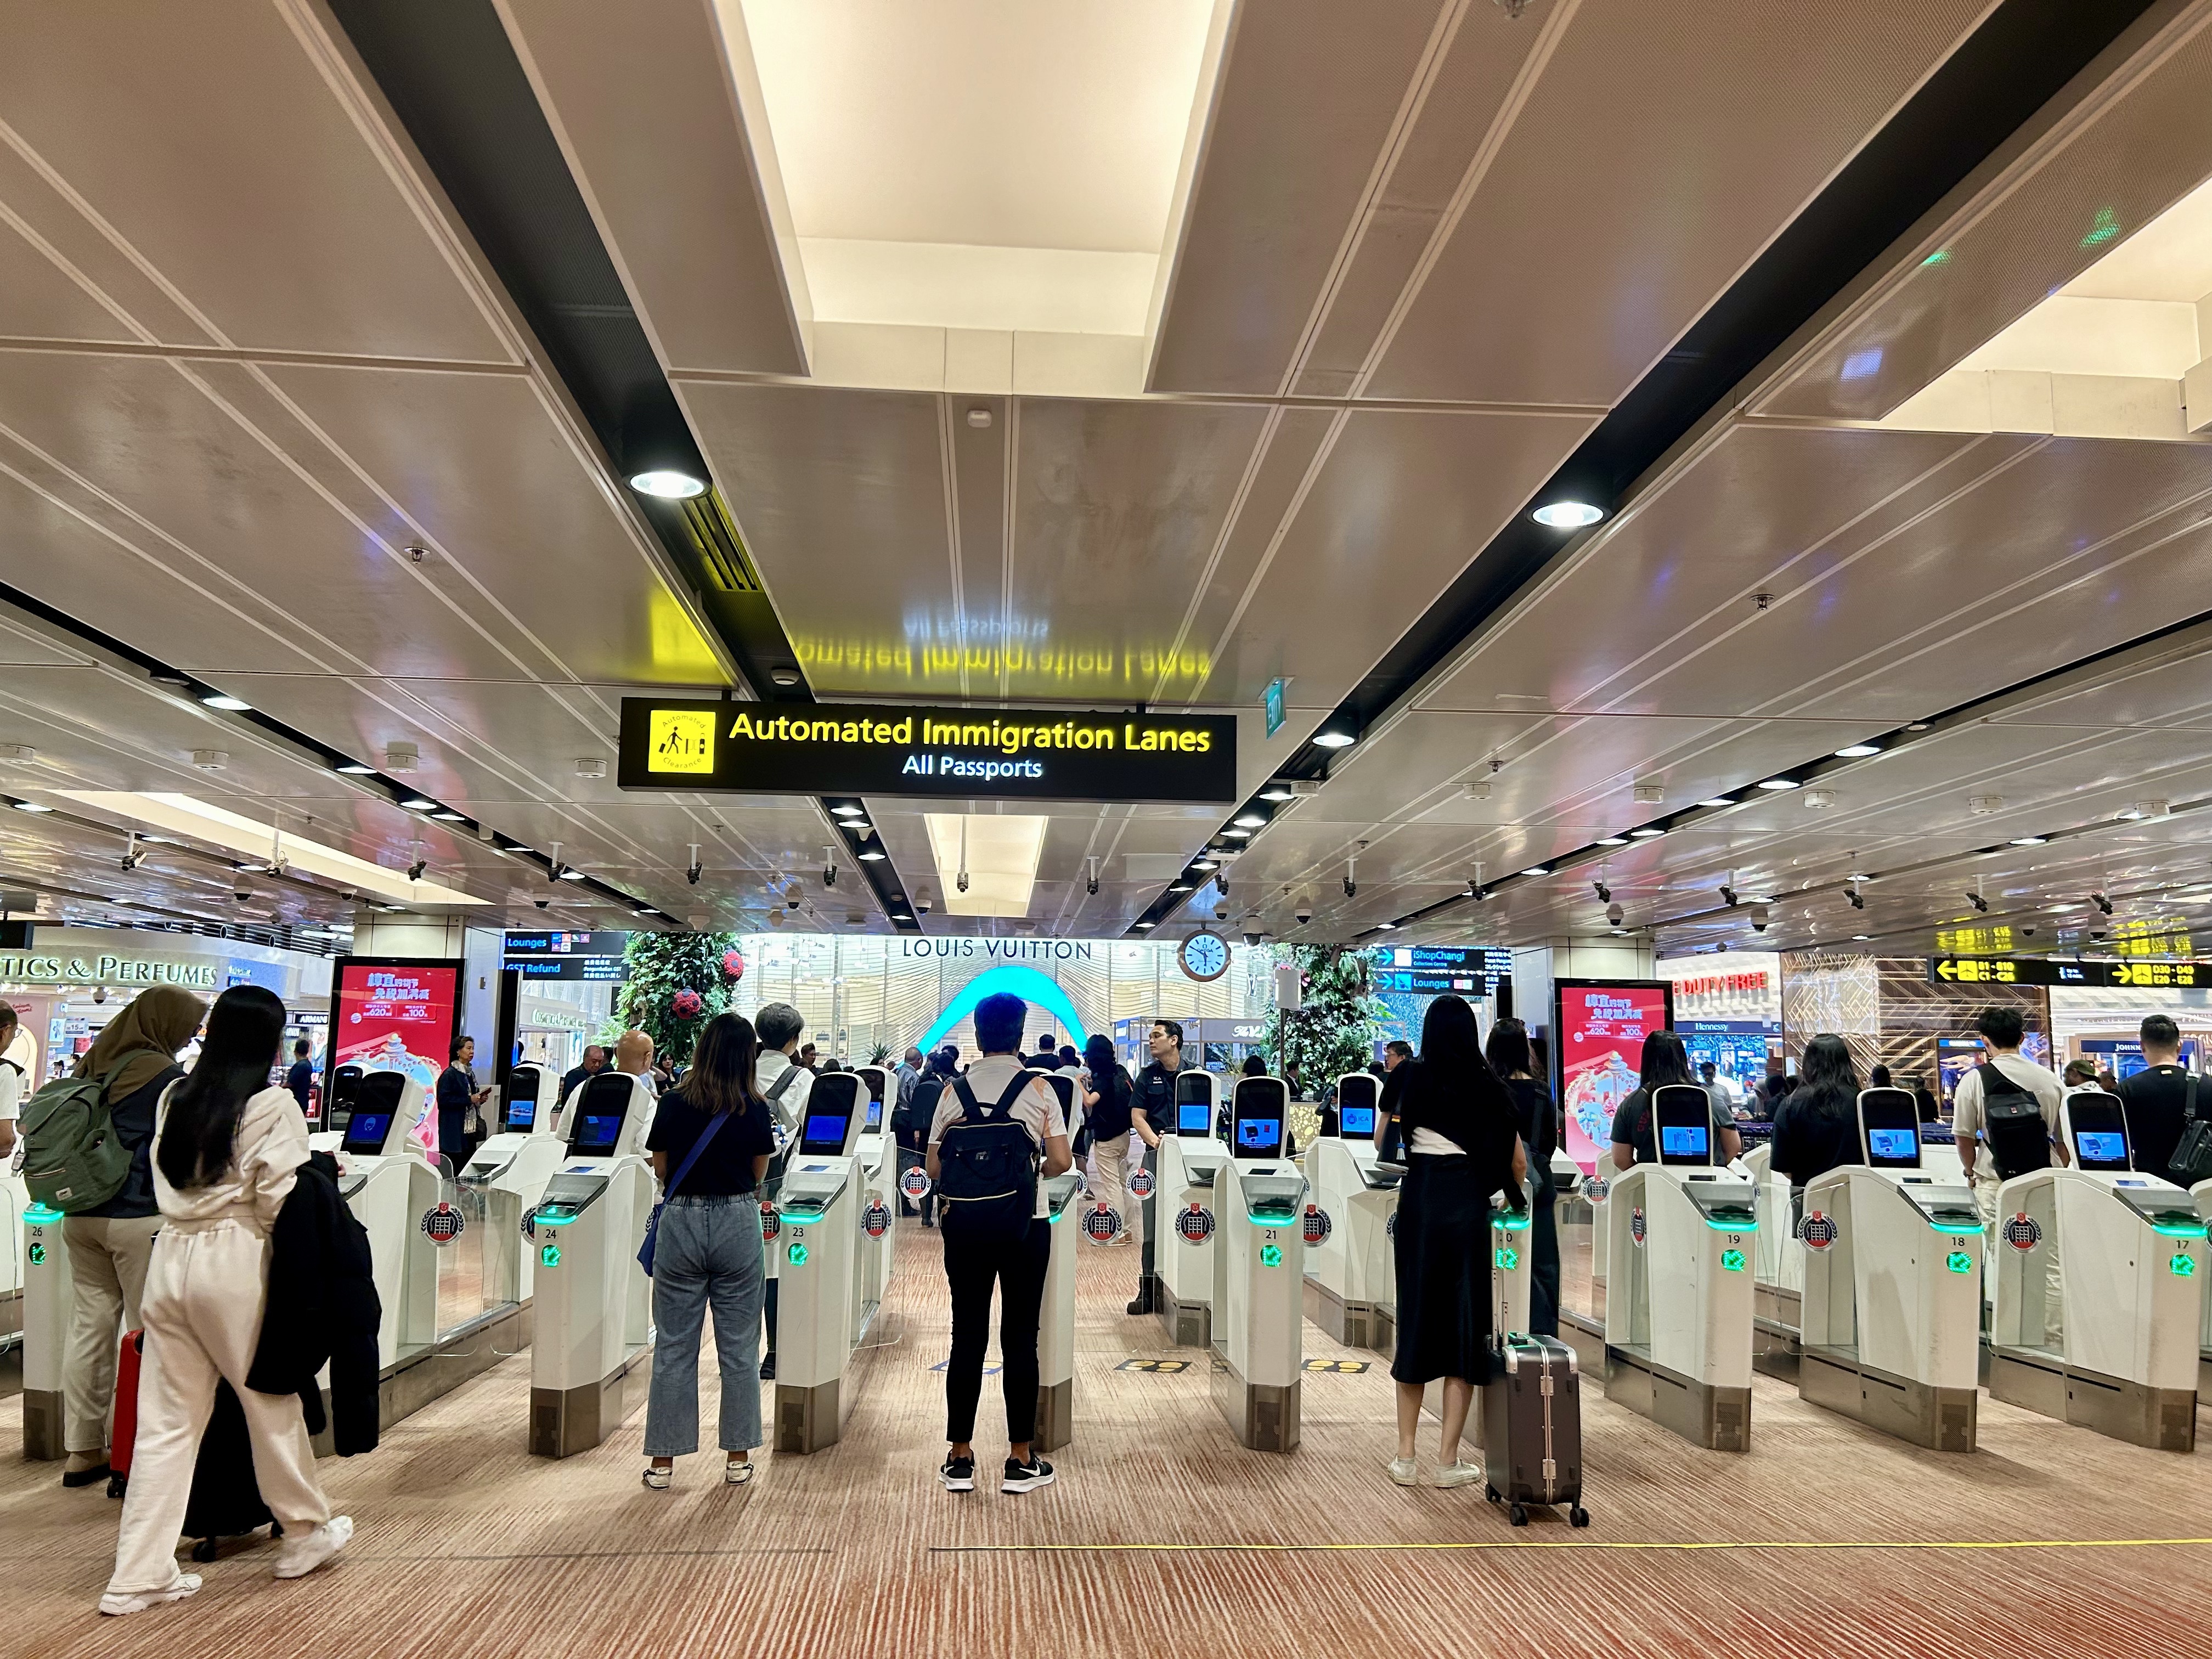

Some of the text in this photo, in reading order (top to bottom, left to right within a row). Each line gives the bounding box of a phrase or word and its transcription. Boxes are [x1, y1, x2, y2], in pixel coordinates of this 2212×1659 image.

[663, 715, 706, 729] Automated
[729, 713, 1210, 754] Automated Immigration Lanes
[663, 757, 702, 769] Clearance
[902, 754, 1042, 781] All Passports
[507, 939, 547, 948] Lounges
[904, 939, 1091, 960] LOUIS VUITTON
[1413, 951, 1465, 962] iShopChangi
[67, 960, 91, 978] &
[99, 957, 218, 986] PERFUMES
[526, 964, 561, 973] Refund
[2153, 965, 2170, 974] D30
[2177, 966, 2194, 974] D49
[1414, 978, 1449, 990] Lounges
[1682, 976, 1723, 995] DUTY
[1724, 972, 1768, 991] FREE
[2154, 975, 2170, 984] E20
[2177, 975, 2193, 984] E28
[1695, 1023, 1728, 1032] Hennessy
[32, 1227, 42, 1236] 26
[545, 1229, 556, 1239] 24
[793, 1228, 804, 1237] 23
[1265, 1229, 1277, 1239] 21
[1727, 1234, 1740, 1244] 19
[1951, 1237, 1965, 1246] 18
[2176, 1240, 2189, 1249] 17
